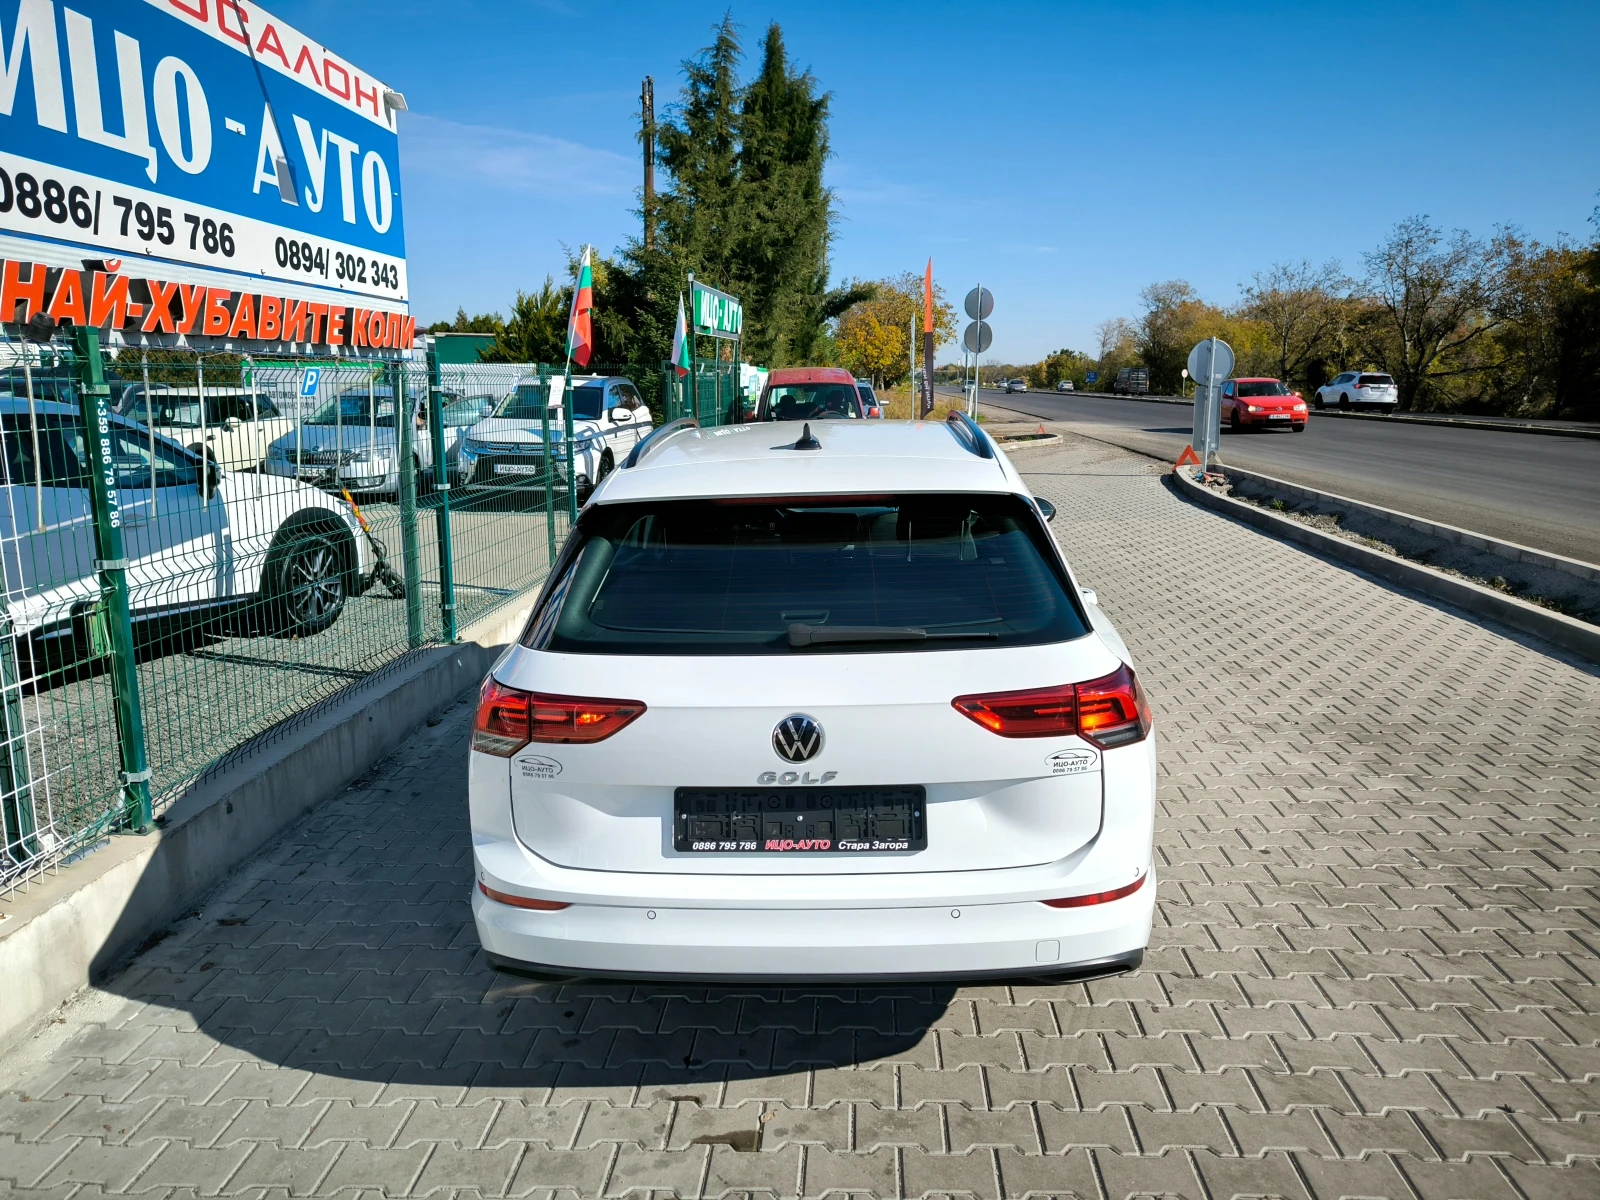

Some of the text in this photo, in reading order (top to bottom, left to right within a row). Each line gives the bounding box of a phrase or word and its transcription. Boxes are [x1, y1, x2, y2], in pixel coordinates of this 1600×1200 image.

[113, 195, 175, 246] 795
[184, 213, 236, 258] 786
[335, 251, 367, 284] 302
[371, 260, 399, 290] 343
[0, 260, 416, 351] НАЙ-ХУБАВИТЕ КОЛИ
[700, 290, 743, 335] ИЦО-АУТО
[97, 399, 120, 529] +359 886 79 57 86
[522, 765, 554, 773] ИЦО-АУТО
[757, 771, 838, 785] GOLF
[1053, 759, 1088, 768] ИЦО-АУТО
[692, 839, 909, 852] 0886 795 786 ИЦО-АУТО Стара Загора
